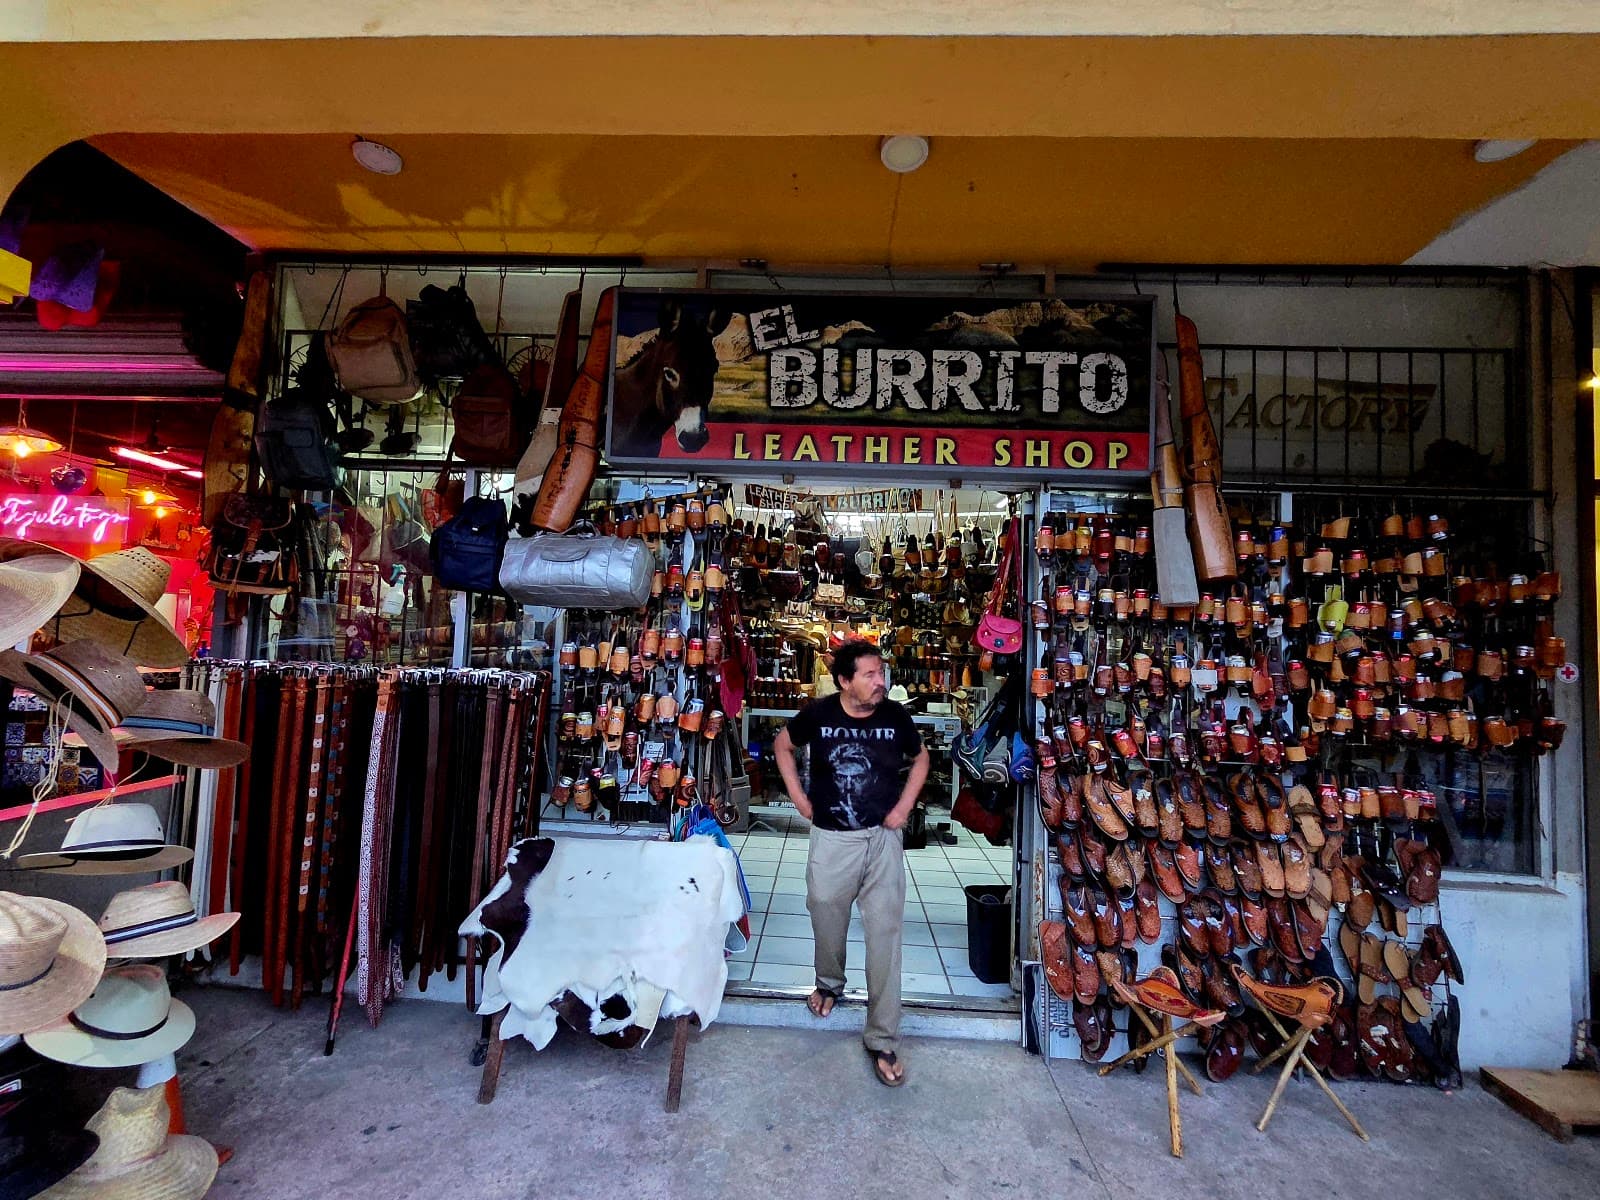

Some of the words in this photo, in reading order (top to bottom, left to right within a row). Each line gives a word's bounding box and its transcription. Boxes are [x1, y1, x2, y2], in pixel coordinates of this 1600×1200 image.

[749, 304, 820, 351] EL
[770, 348, 1128, 413] BURRITO
[734, 433, 958, 464] LEATHER
[994, 439, 1128, 469] SHOP
[749, 484, 799, 504] LEATHER
[760, 498, 790, 510] SHOP
[820, 726, 895, 740] BOWIE
